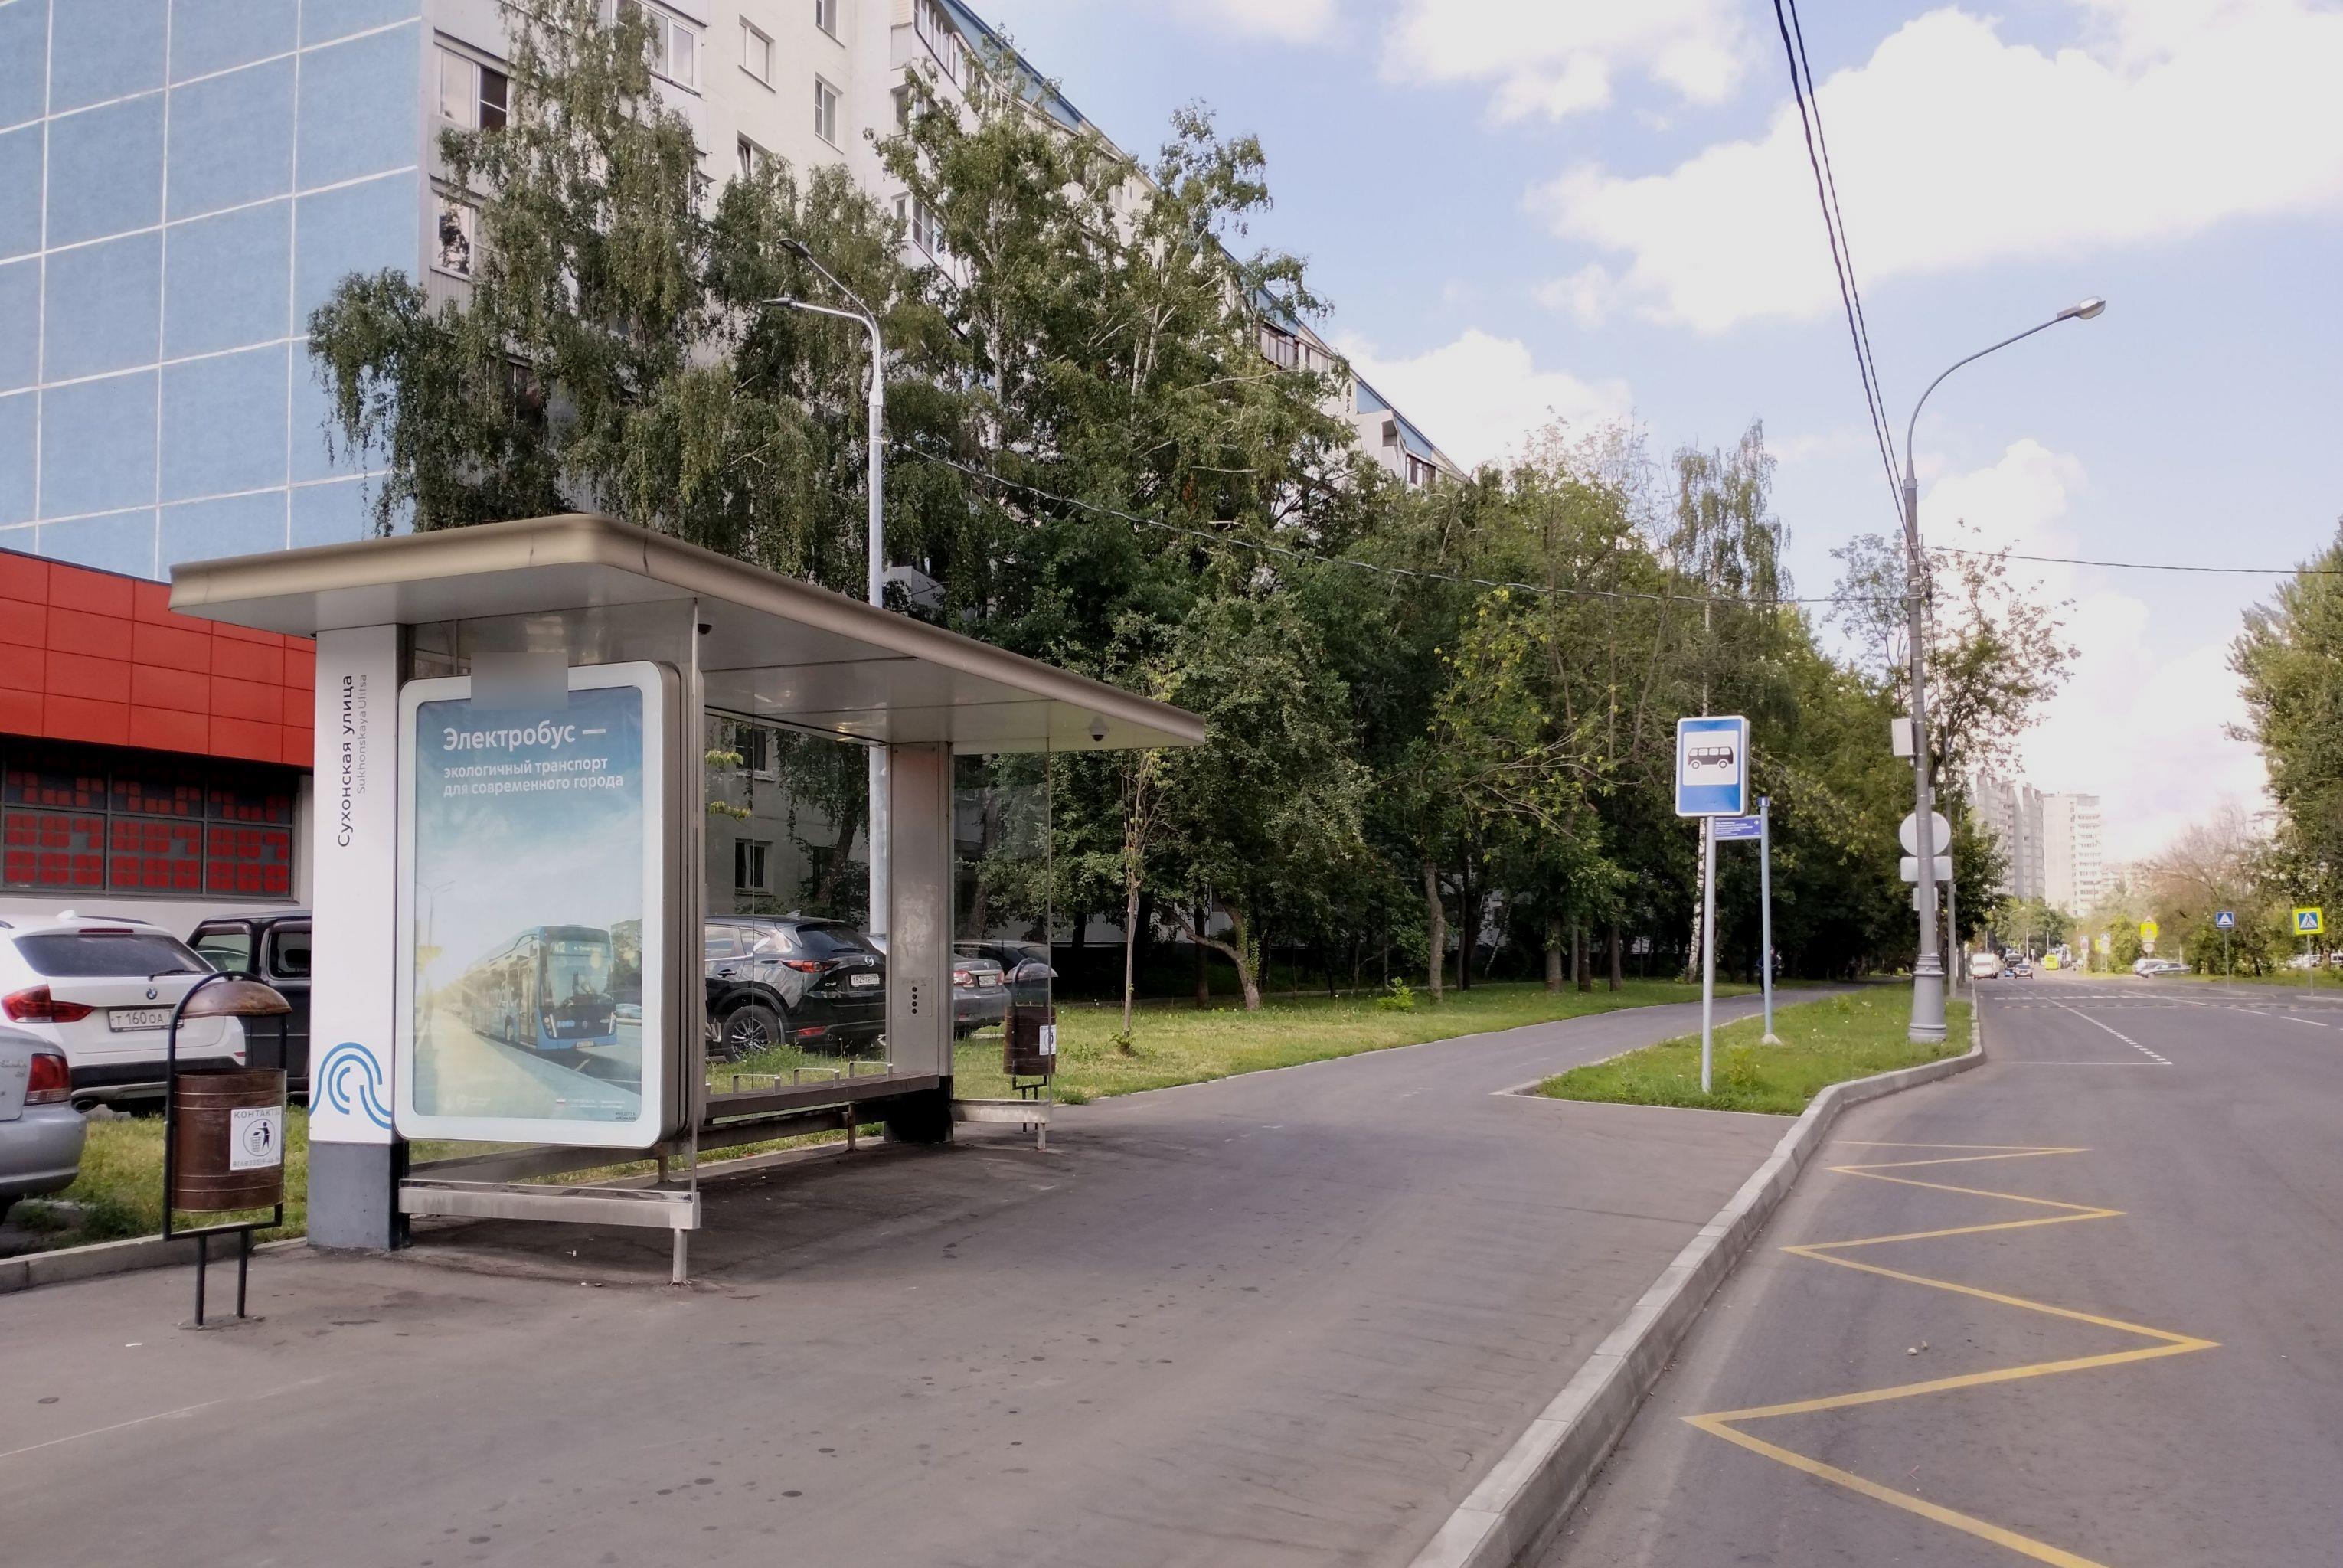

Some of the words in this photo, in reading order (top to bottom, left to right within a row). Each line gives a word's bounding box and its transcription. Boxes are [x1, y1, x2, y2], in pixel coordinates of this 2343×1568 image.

[342, 675, 355, 735] улица
[358, 674, 367, 709] Ulitsa
[358, 711, 368, 794] Sukhonskaya
[443, 720, 576, 752] Электробус
[443, 760, 532, 779] экологичный
[535, 757, 609, 775] транспорт
[338, 742, 353, 847] Сухонская
[443, 784, 469, 797] для
[472, 777, 570, 795] современного
[573, 775, 624, 791] города
